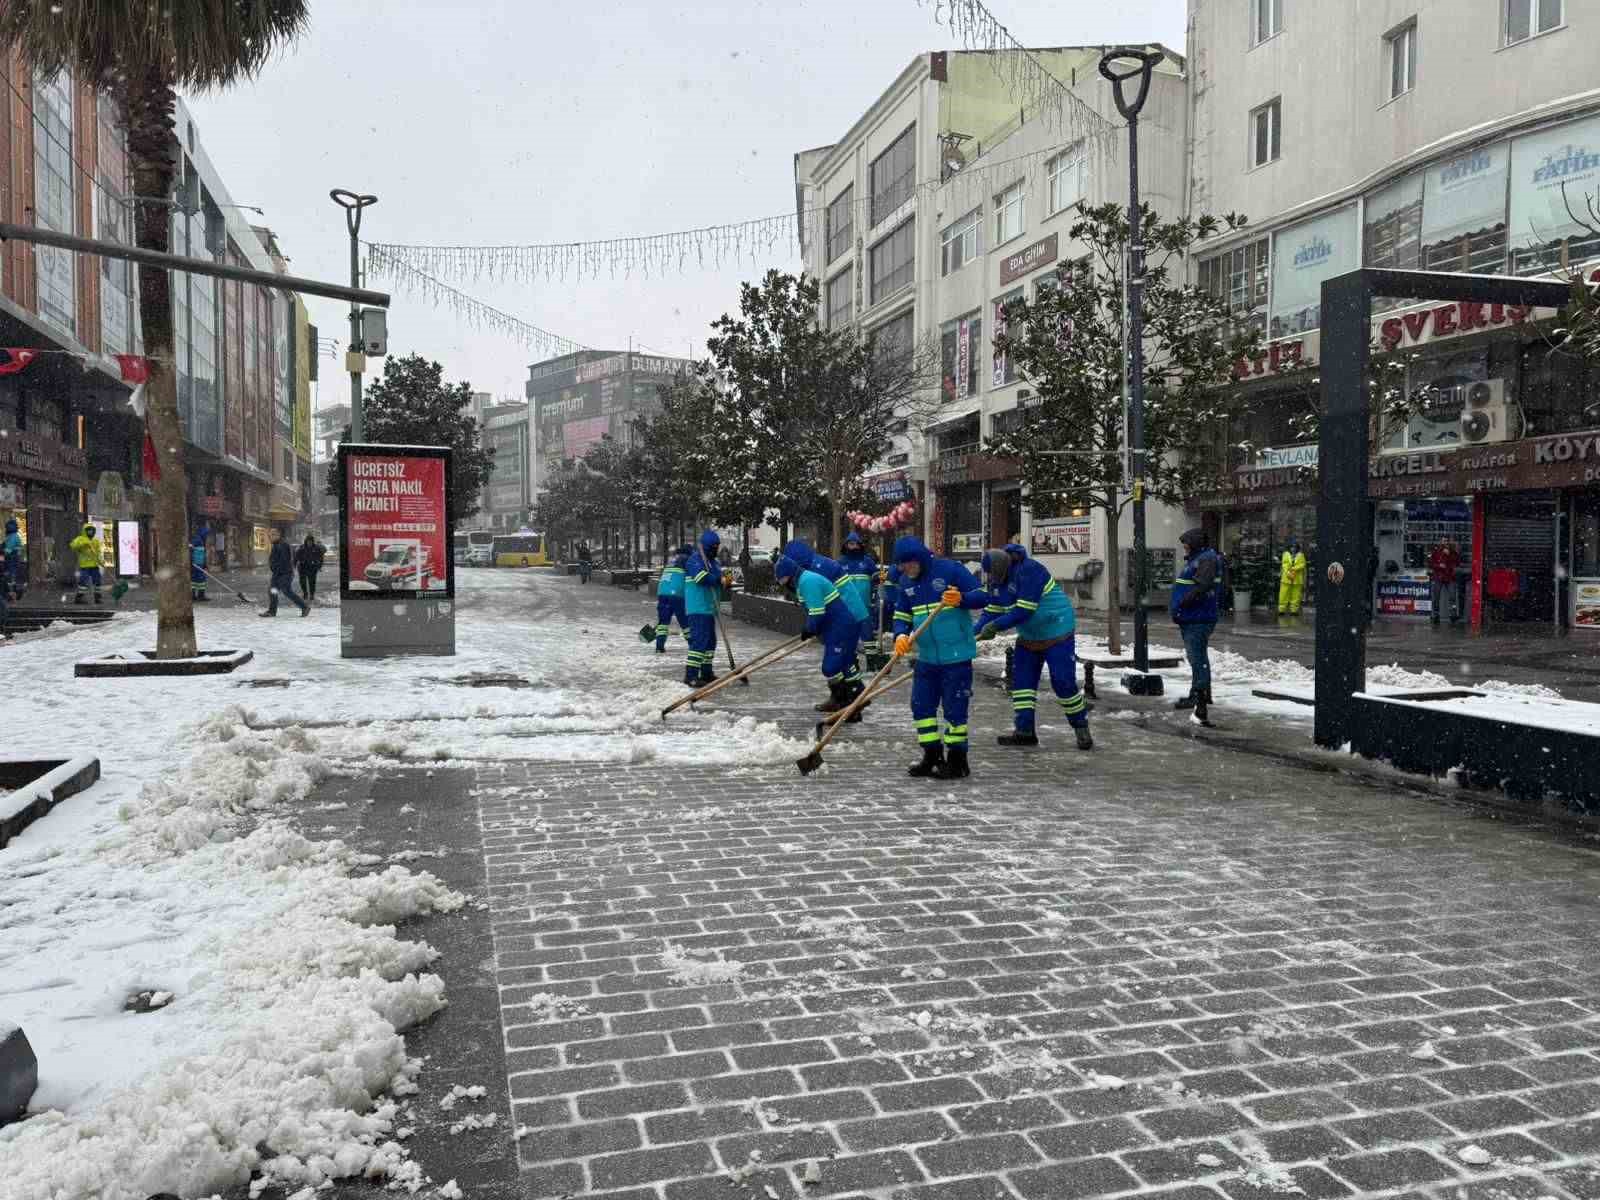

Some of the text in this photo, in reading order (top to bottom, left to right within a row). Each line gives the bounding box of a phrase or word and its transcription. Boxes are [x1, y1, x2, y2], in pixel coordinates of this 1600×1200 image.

[353, 460, 406, 477] ÜCRETSİZ
[353, 479, 424, 496] HASTA NAKİL
[353, 495, 399, 512] HİZMETİ
